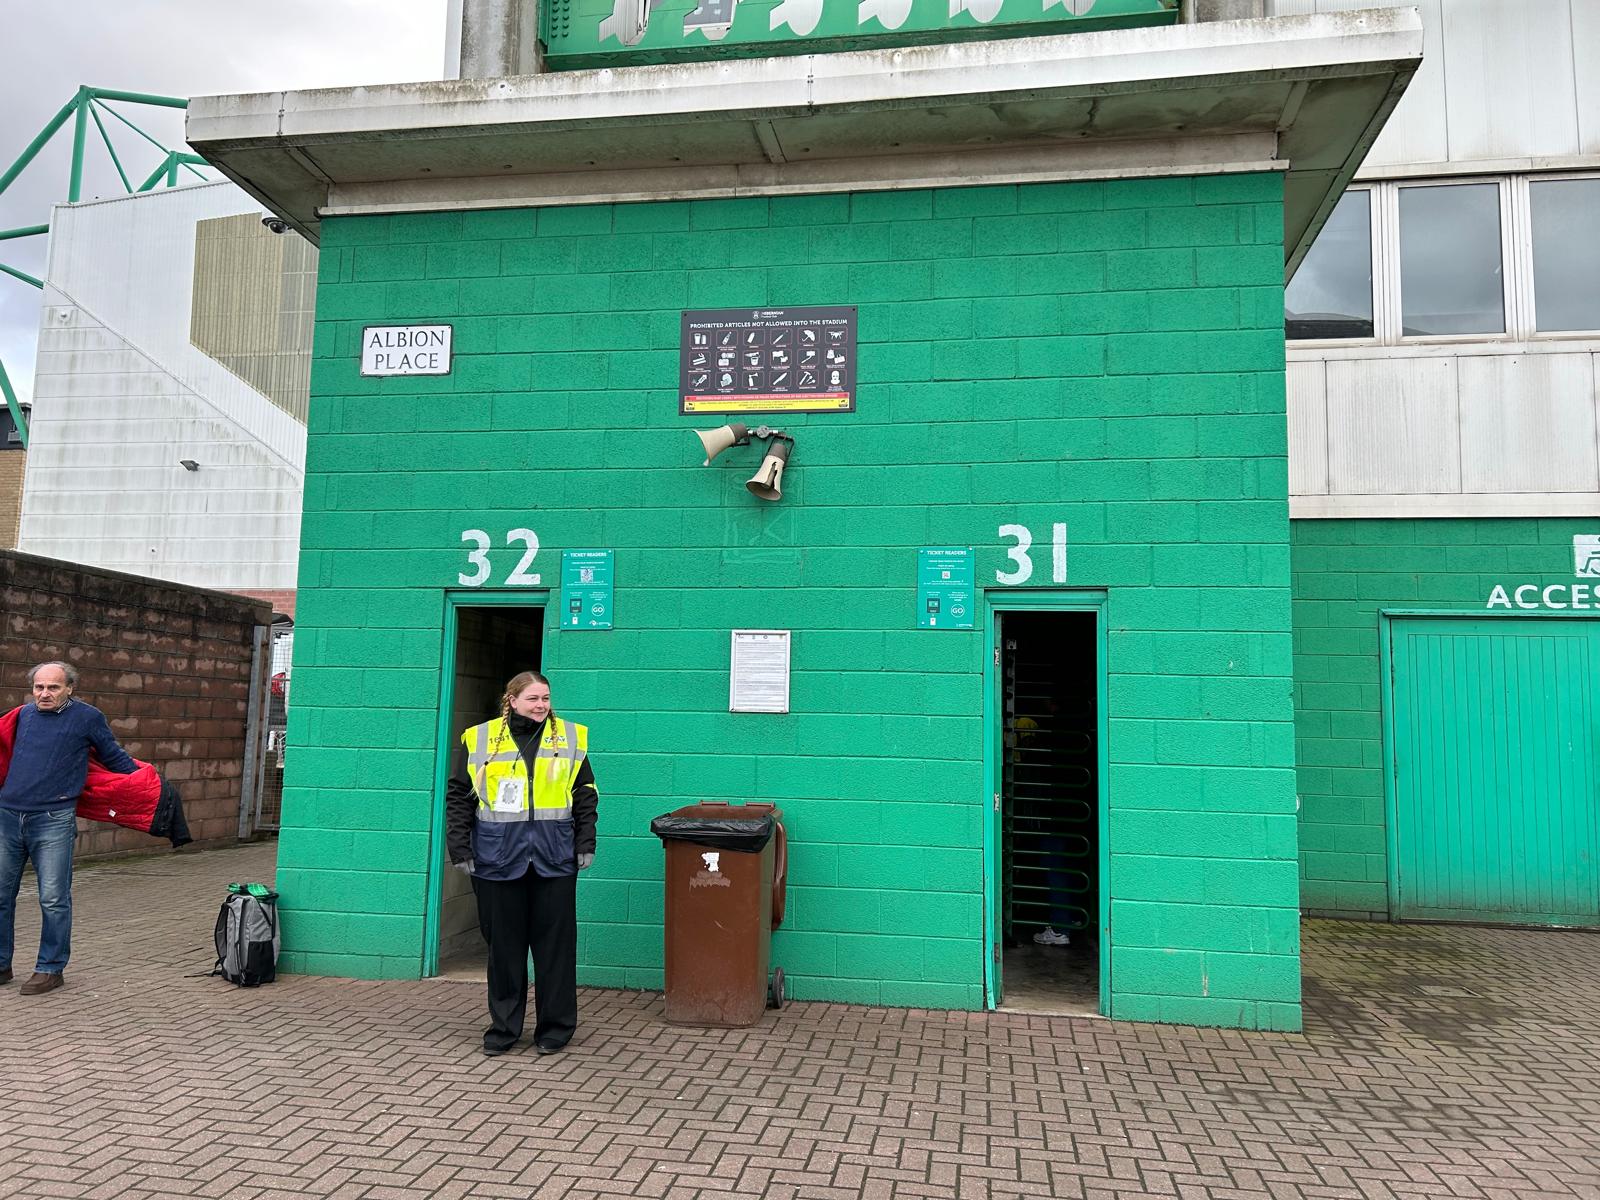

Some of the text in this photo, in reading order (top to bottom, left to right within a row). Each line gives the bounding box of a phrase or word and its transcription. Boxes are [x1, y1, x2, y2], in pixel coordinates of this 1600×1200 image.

[370, 330, 444, 348] ALBION
[374, 352, 438, 370] PLACE
[458, 528, 540, 586] 32
[996, 522, 1066, 585] 31
